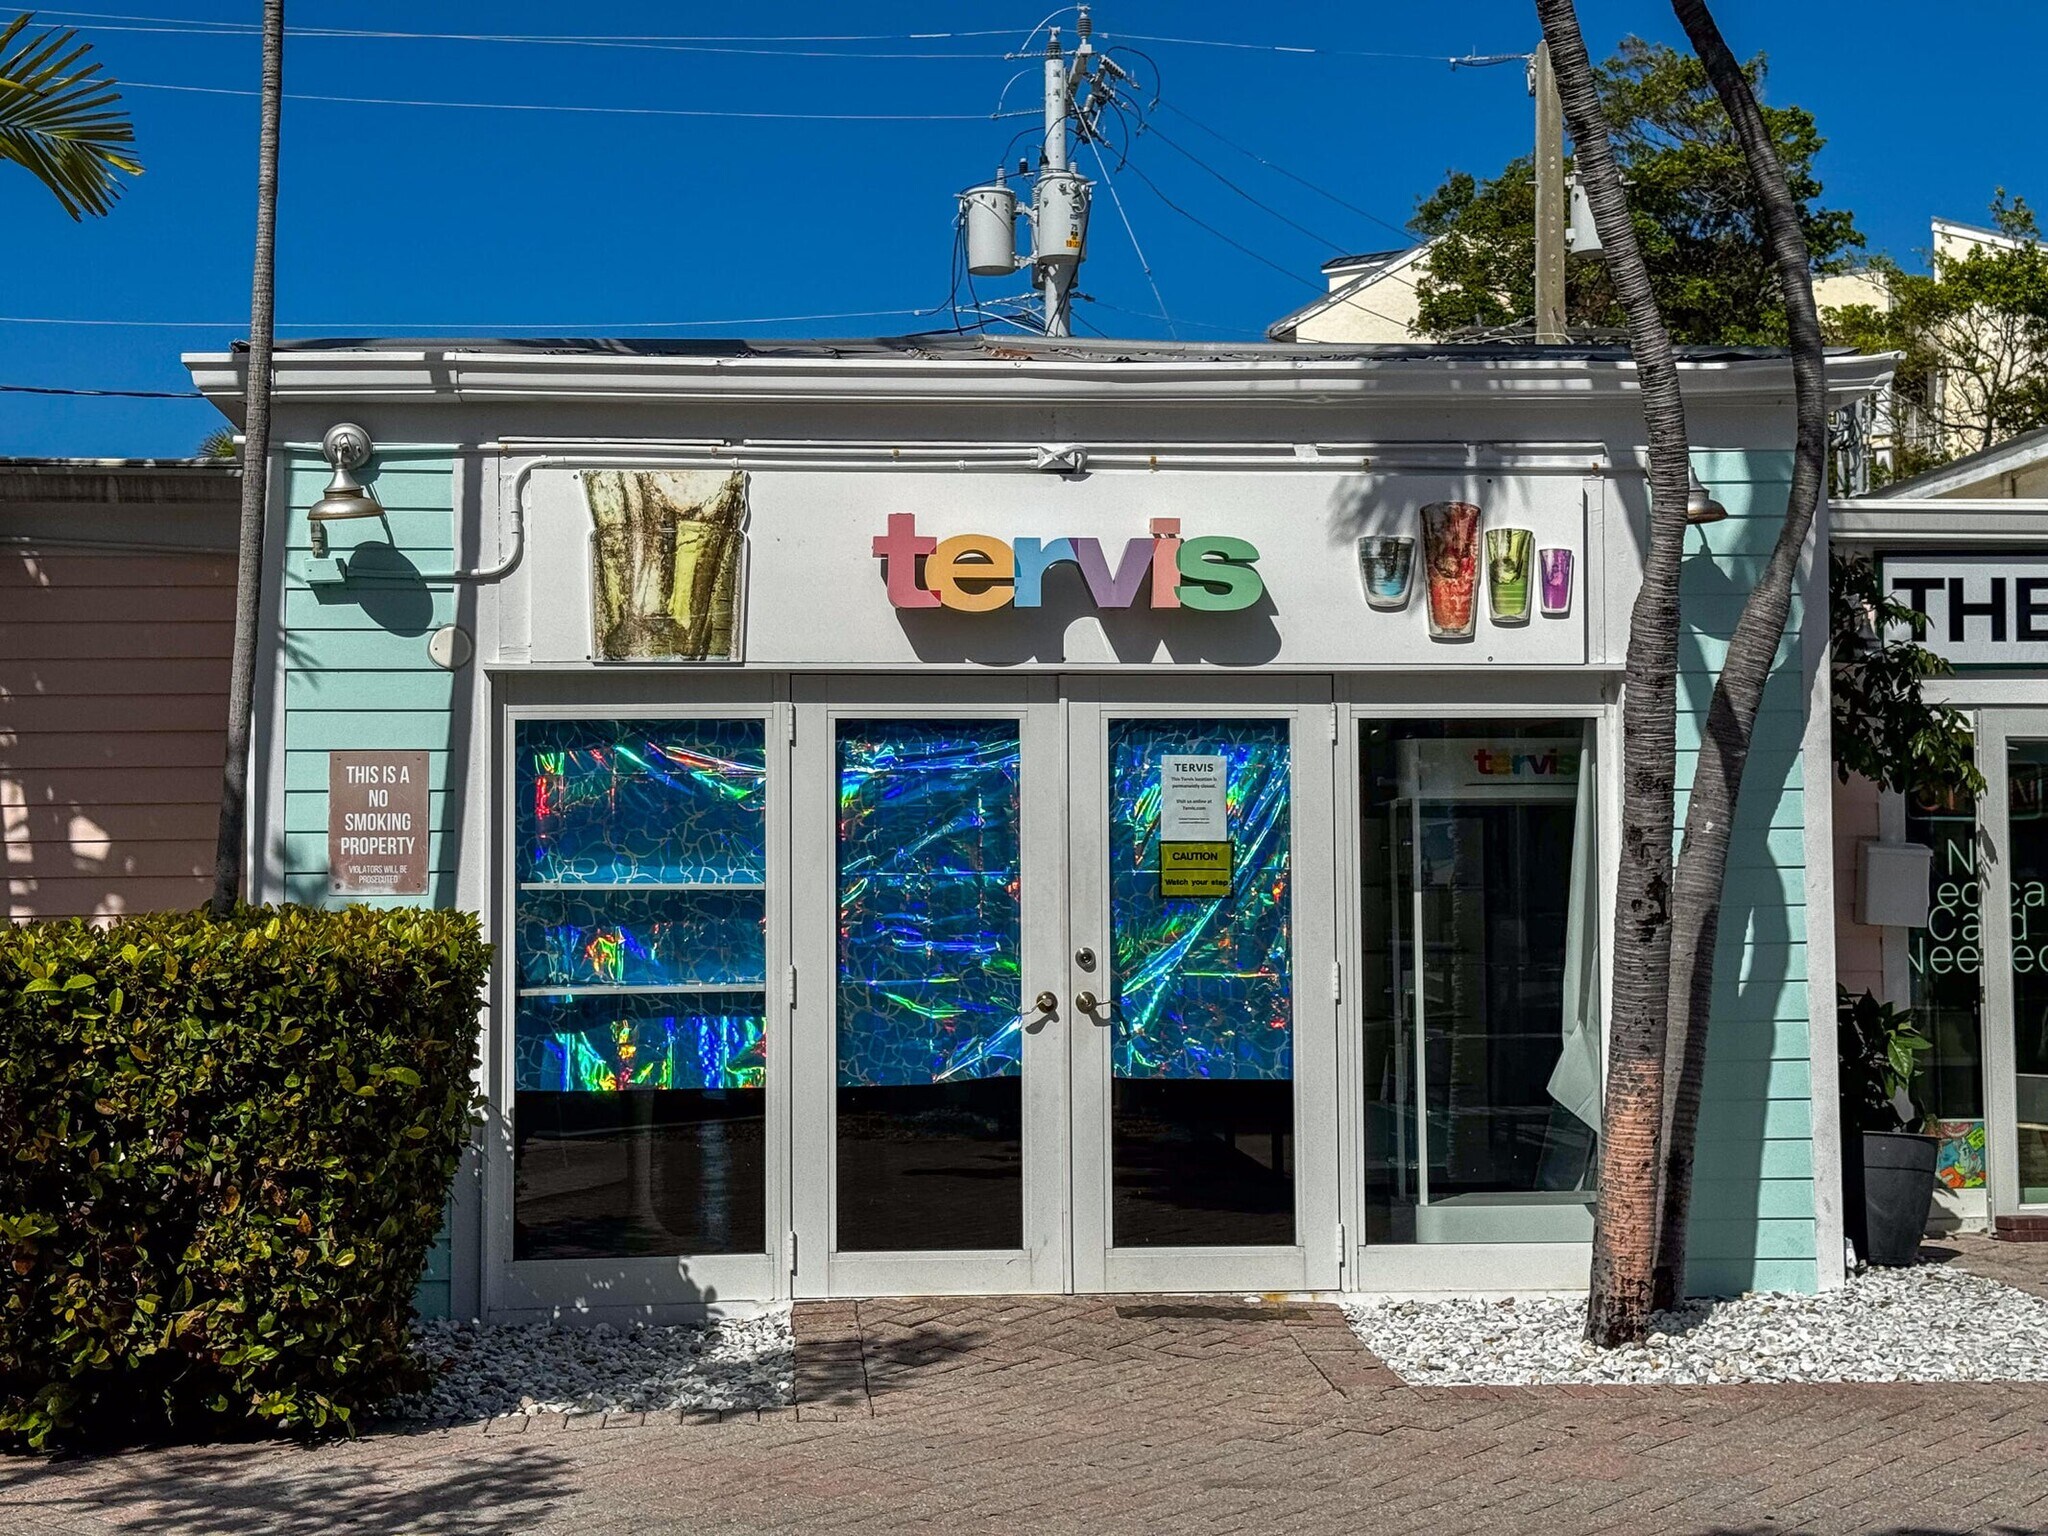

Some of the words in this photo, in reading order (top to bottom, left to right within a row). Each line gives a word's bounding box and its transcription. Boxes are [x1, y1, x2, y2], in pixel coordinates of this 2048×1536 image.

[872, 512, 1264, 613] tervis
[1892, 577, 2048, 642] THE
[1174, 763, 1214, 772] TERVIS
[1474, 748, 1578, 775] tervis
[346, 765, 379, 784] THIS
[383, 765, 396, 784] IS
[400, 765, 410, 784] A
[368, 789, 388, 807] NO
[344, 813, 411, 831] SMOKING
[340, 837, 415, 855] PROPERTY
[1172, 852, 1218, 861] CAUTION
[348, 865, 382, 874] VIOLATORS
[383, 865, 398, 874] WILL
[399, 865, 408, 873] BE
[358, 875, 399, 884] PROSECUTED
[1191, 879, 1208, 887] your
[1211, 879, 1228, 887] step
[1928, 904, 2027, 942] Cad
